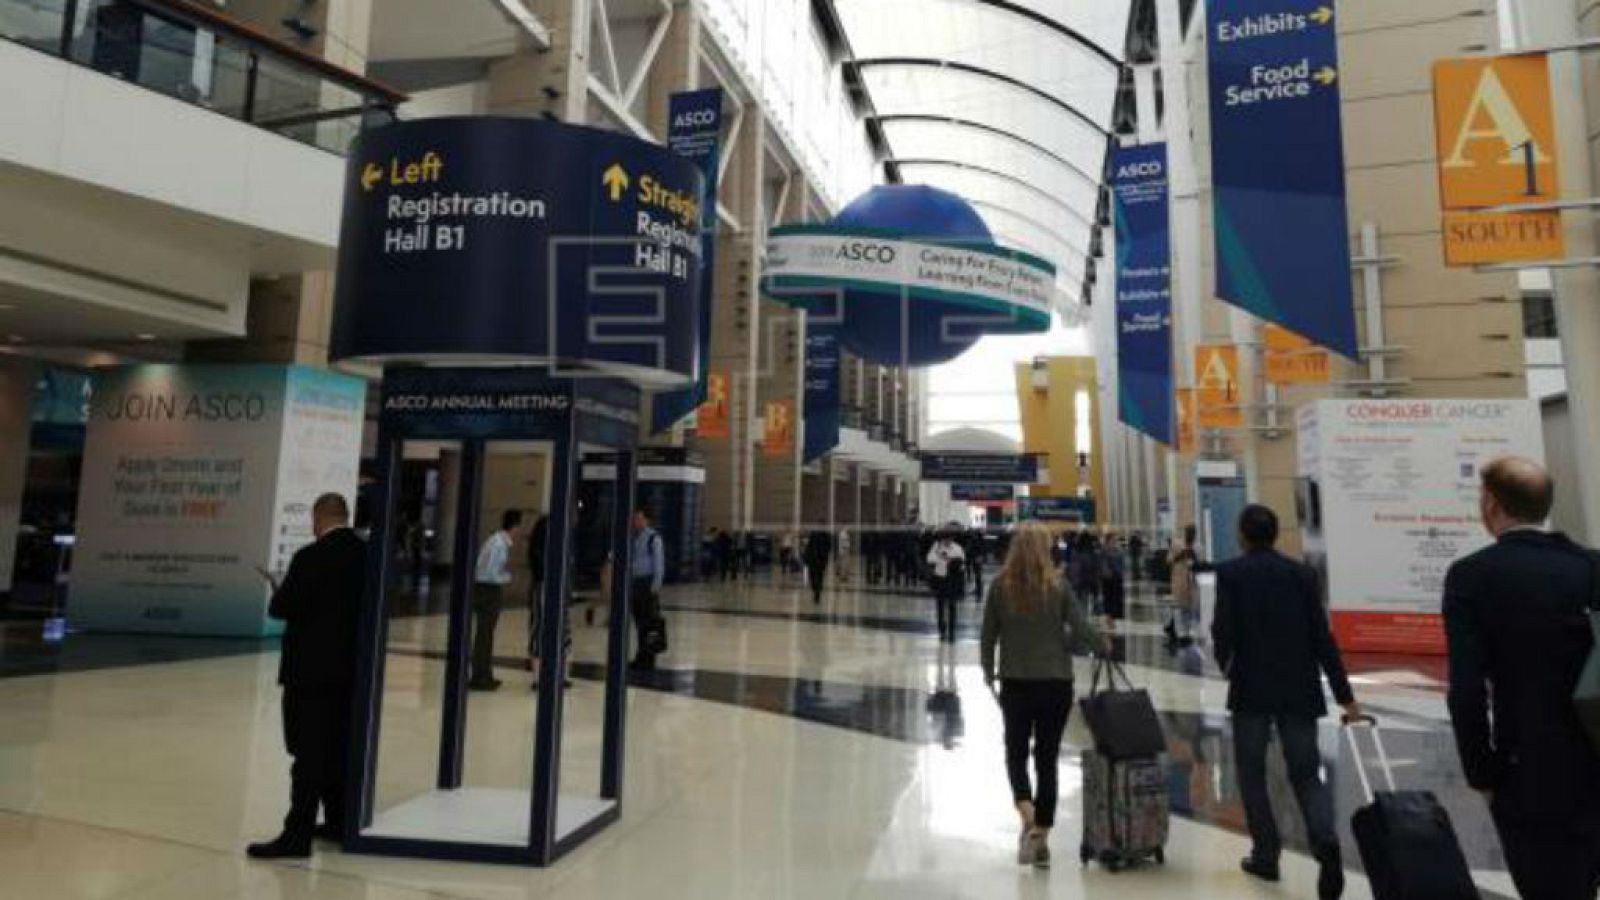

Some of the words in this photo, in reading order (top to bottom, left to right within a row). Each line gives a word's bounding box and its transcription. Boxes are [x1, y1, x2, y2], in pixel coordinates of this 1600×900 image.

[1217, 8, 1307, 42] Exhibits
[1251, 58, 1309, 85] Food
[1224, 79, 1311, 107] Service
[674, 108, 715, 127] ASCO
[1442, 65, 1551, 167] A
[1511, 140, 1545, 196] 1
[390, 151, 443, 185] Left
[1117, 160, 1162, 178] ASCO
[387, 191, 546, 224] Registration
[384, 225, 428, 254] Hall
[436, 224, 466, 251] B1
[1450, 213, 1557, 244] SOUTH
[635, 242, 671, 273] Hall
[836, 242, 896, 264] ASCO
[107, 394, 175, 420] JOIN
[182, 394, 266, 421] ASCO
[385, 394, 427, 410] ASCO
[430, 394, 493, 410] ANNUAL
[499, 394, 570, 410] MEETING
[1346, 401, 1432, 418] CONQUER
